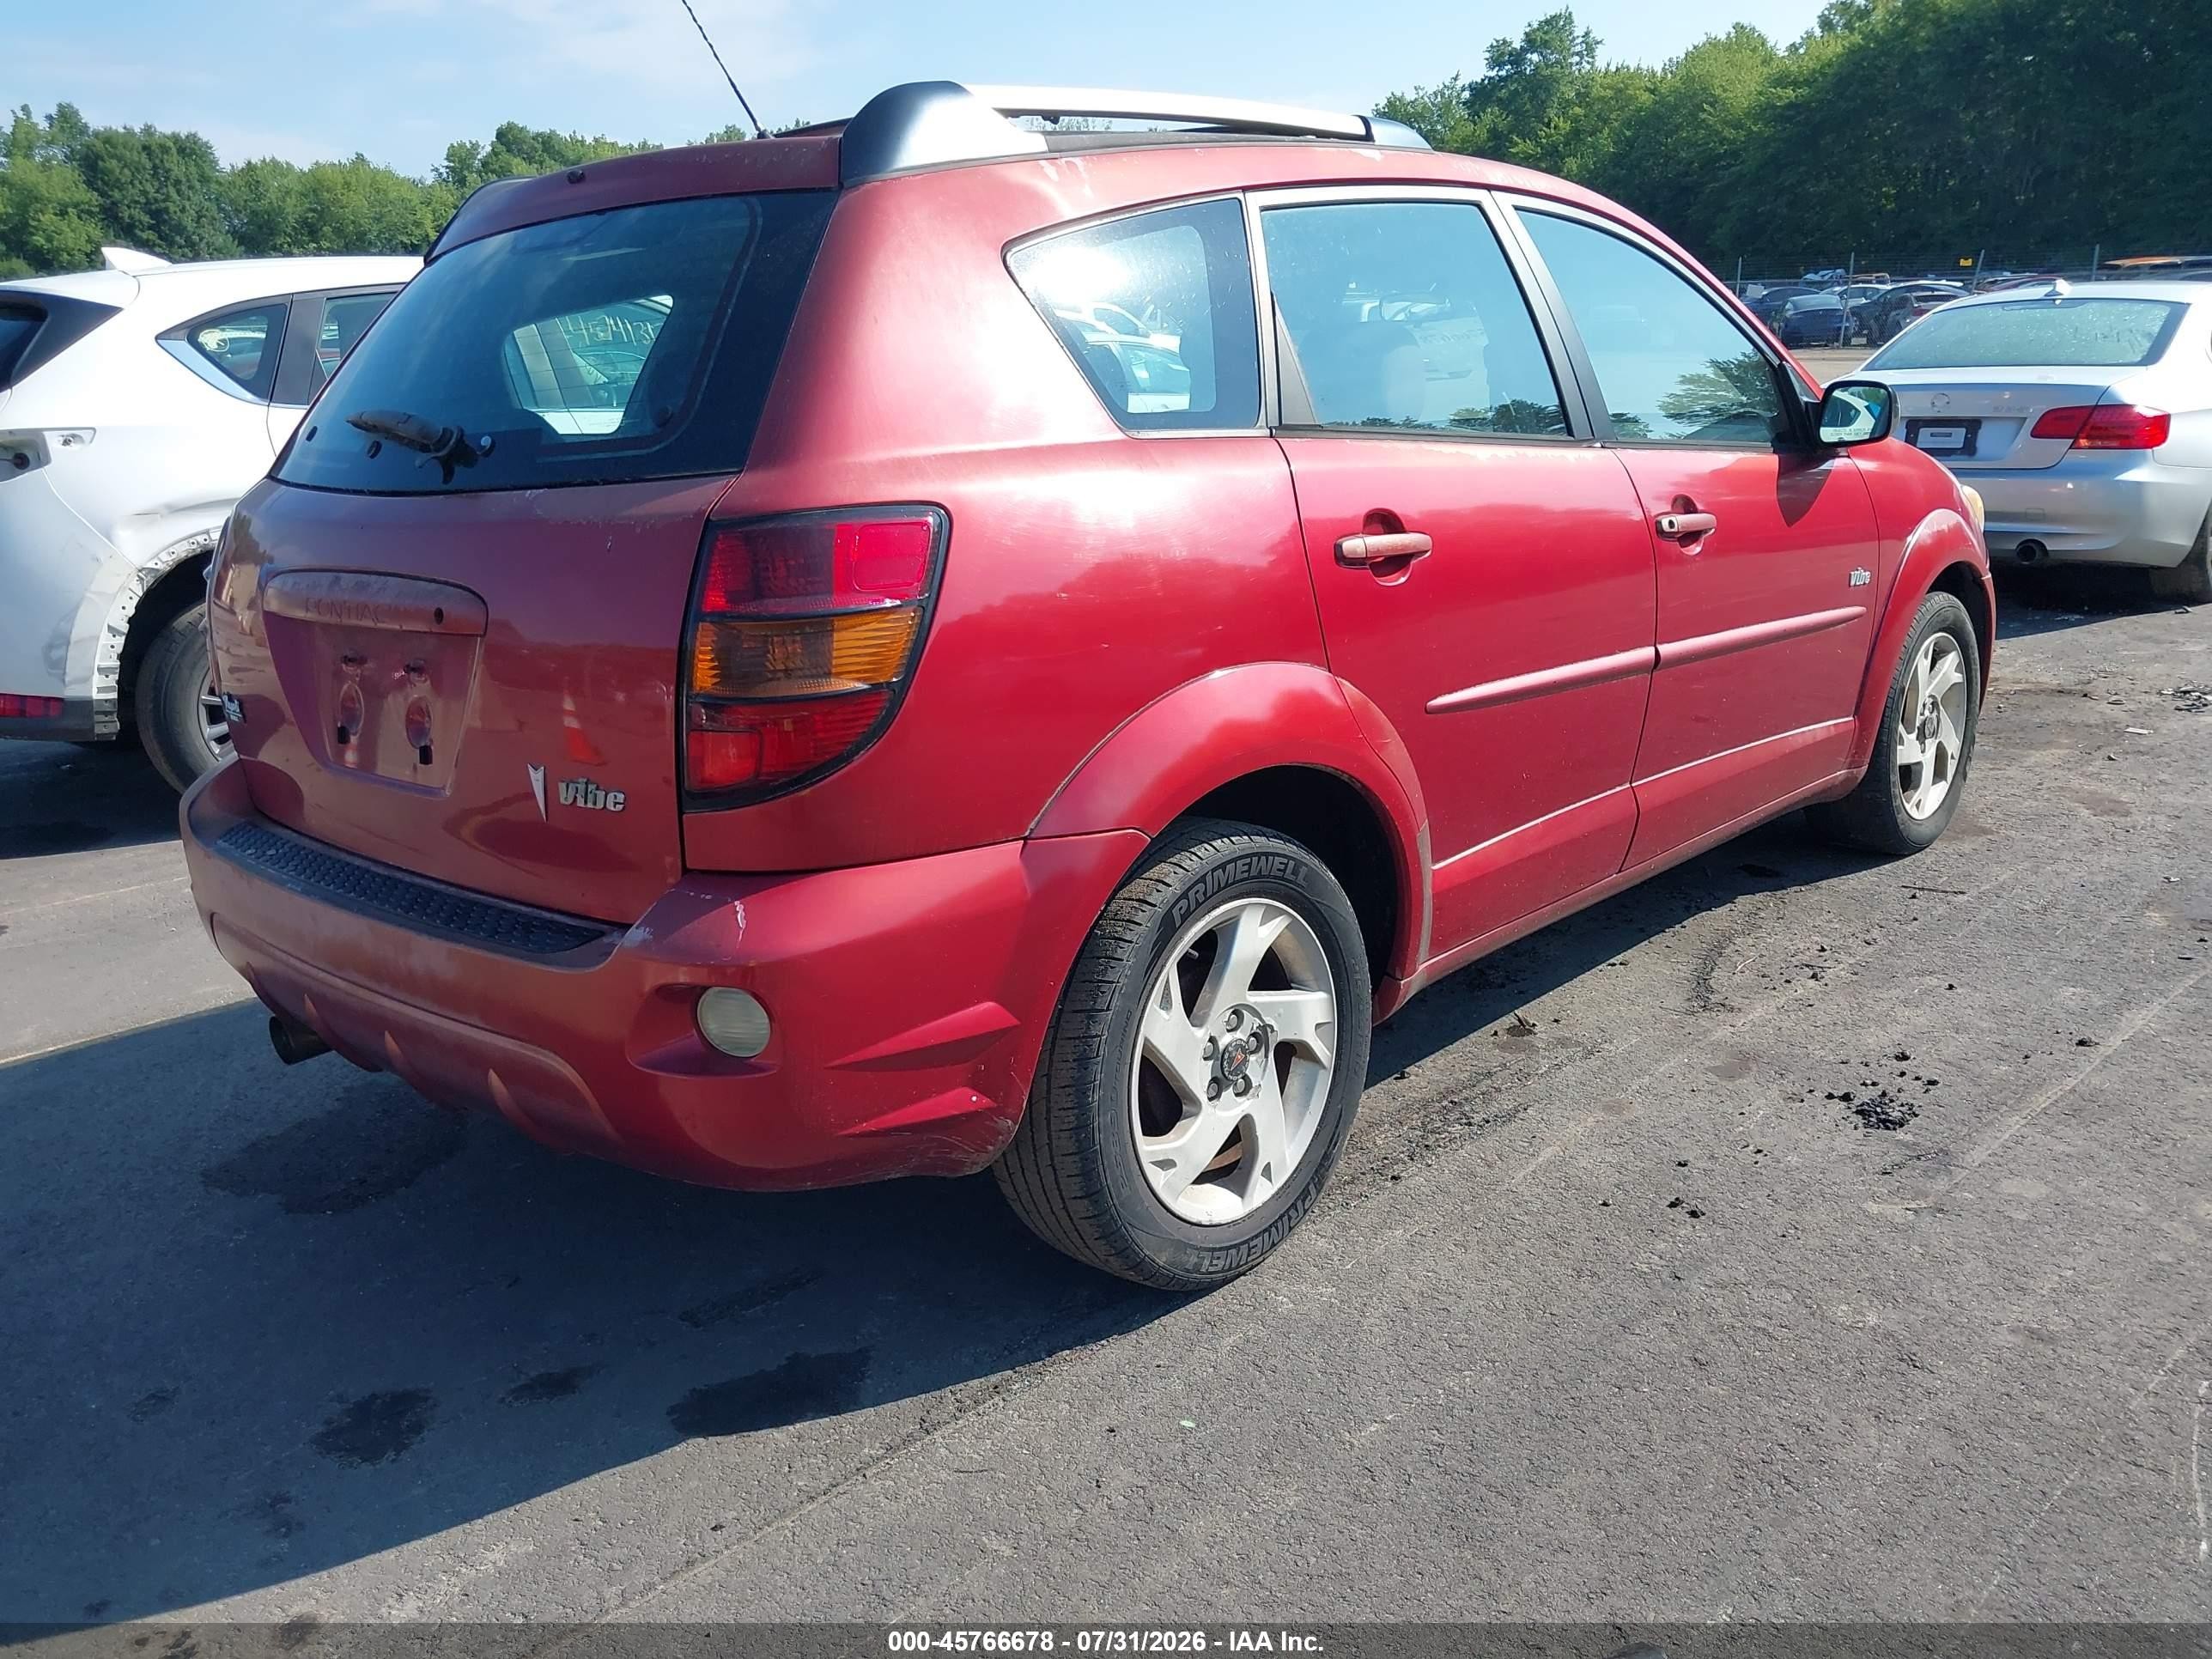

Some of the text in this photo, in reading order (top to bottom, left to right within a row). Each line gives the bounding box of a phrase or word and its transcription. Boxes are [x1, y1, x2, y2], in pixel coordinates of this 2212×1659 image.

[305, 597, 386, 624] PONTIAC
[558, 777, 626, 811] vibe
[1172, 856, 1311, 928] PRIMEWELL
[1183, 1182, 1319, 1273] PRIMEWELL
